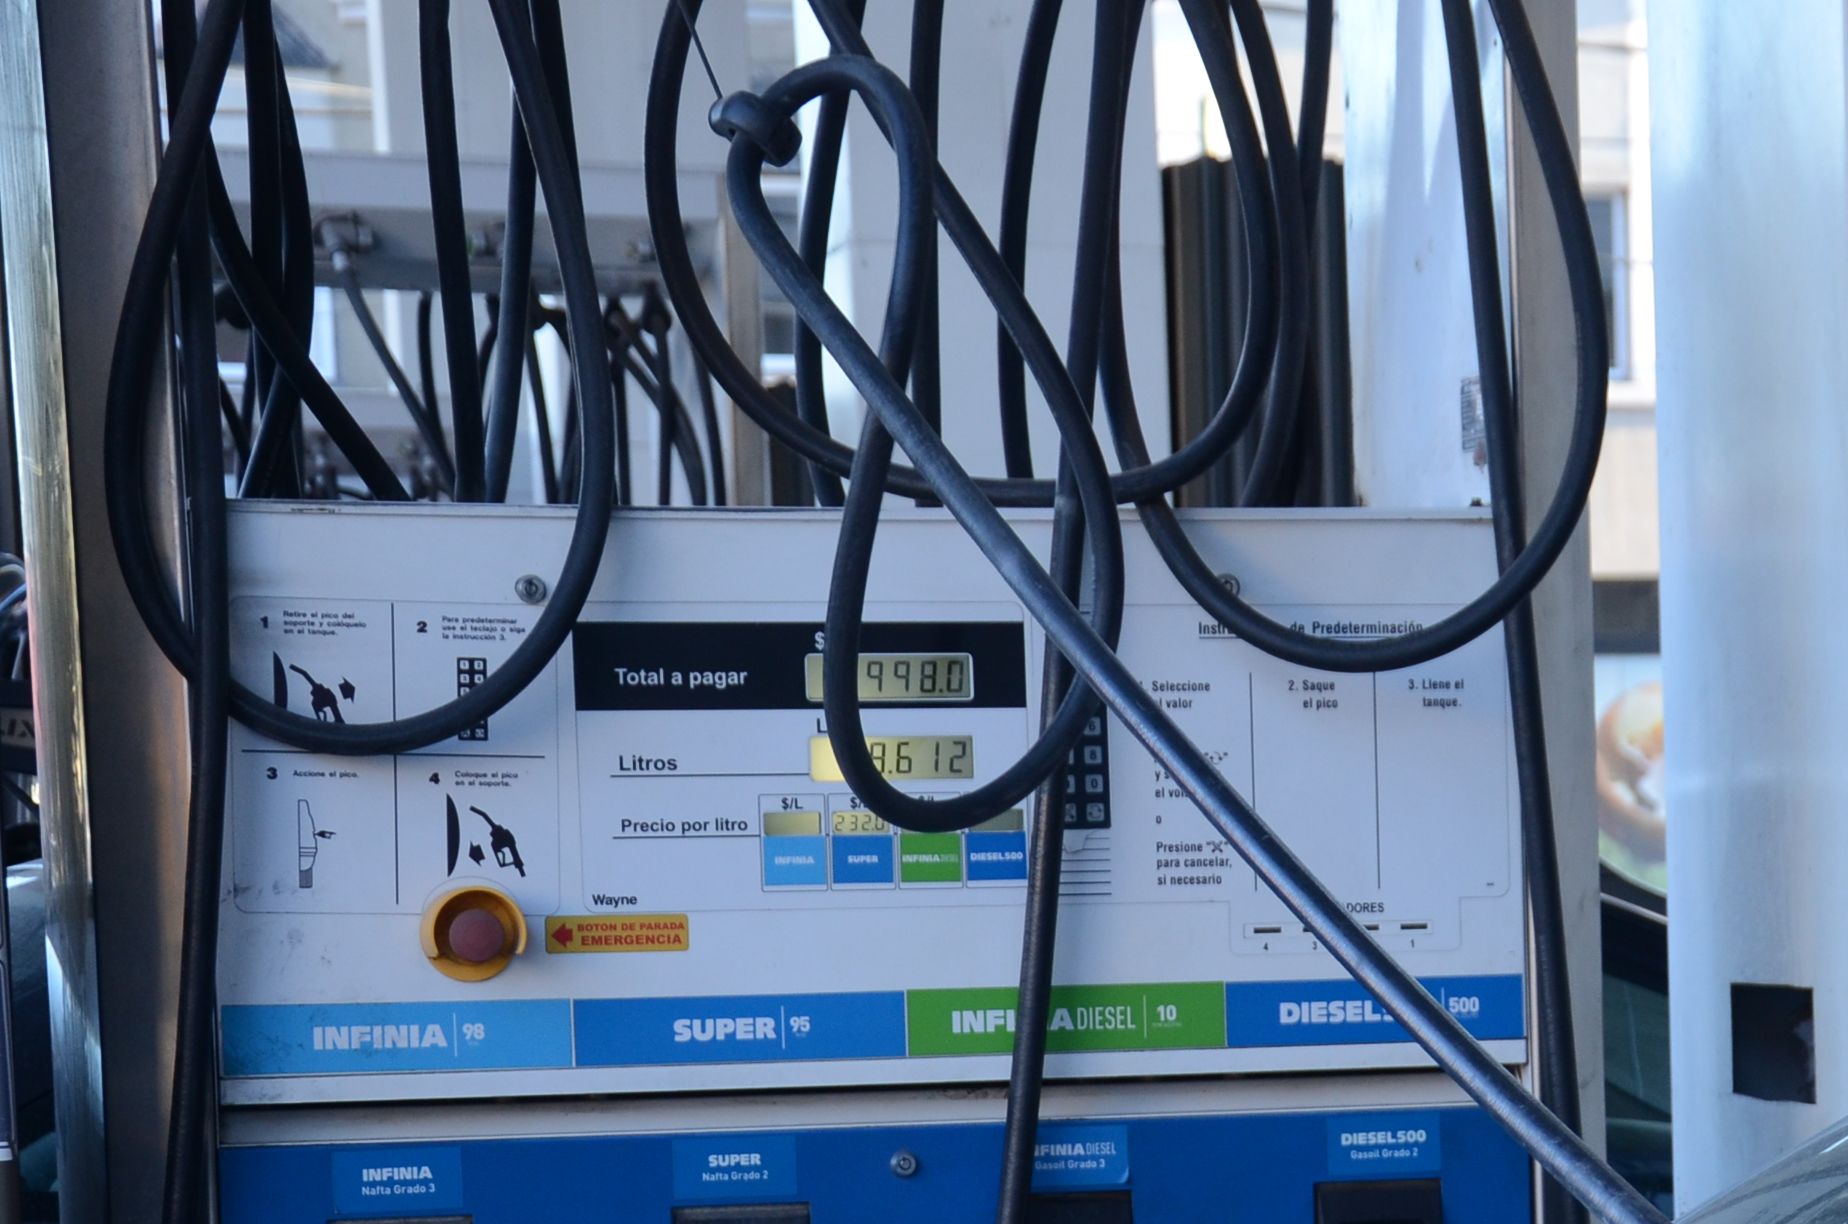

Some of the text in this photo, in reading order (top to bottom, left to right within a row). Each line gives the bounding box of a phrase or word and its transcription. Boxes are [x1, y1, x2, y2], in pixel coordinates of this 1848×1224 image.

[260, 616, 269, 629] 1
[416, 621, 428, 633] 2
[1311, 620, 1424, 635] Predeterminación
[614, 667, 748, 690] Total a pagar
[1408, 678, 1464, 690] 3. Llene el
[1151, 680, 1211, 692] Seleccione
[1288, 679, 1336, 693] 2. Saque
[1166, 698, 1193, 709] valor
[1303, 697, 1339, 711] el pico
[1422, 695, 1462, 709] tanque.
[618, 755, 678, 772] Litros
[266, 767, 278, 780] 3
[429, 772, 440, 785] 4
[1154, 787, 1165, 798] el
[781, 797, 803, 811] $/L
[620, 817, 749, 835] Precio por litro
[1156, 841, 1204, 853] Presione
[774, 855, 815, 865] INFINIA
[847, 854, 879, 864] SUPER
[970, 851, 1024, 862] DIESEL500
[1156, 856, 1233, 870] para cancelar,
[1157, 874, 1222, 886] si necesario
[591, 893, 638, 909] Wayne
[577, 921, 685, 932] BOTON DE PARADA
[580, 933, 683, 946] EMERGENCIA
[1449, 996, 1480, 1013] 500
[1156, 1004, 1177, 1022] 10
[673, 1015, 810, 1042] SUPER 95
[312, 1022, 486, 1050] INFINIA 98
[1340, 1129, 1427, 1146] DIESEL500
[1350, 1147, 1419, 1160] Gasoil Grado 2
[708, 1153, 762, 1168] SUPER
[1035, 1160, 1065, 1170] Gasoil
[1067, 1159, 1098, 1169] Grado
[361, 1165, 433, 1182] INFINIA
[702, 1169, 769, 1182] Nafta Grado 2
[361, 1182, 436, 1196] Nafta Grado 3
